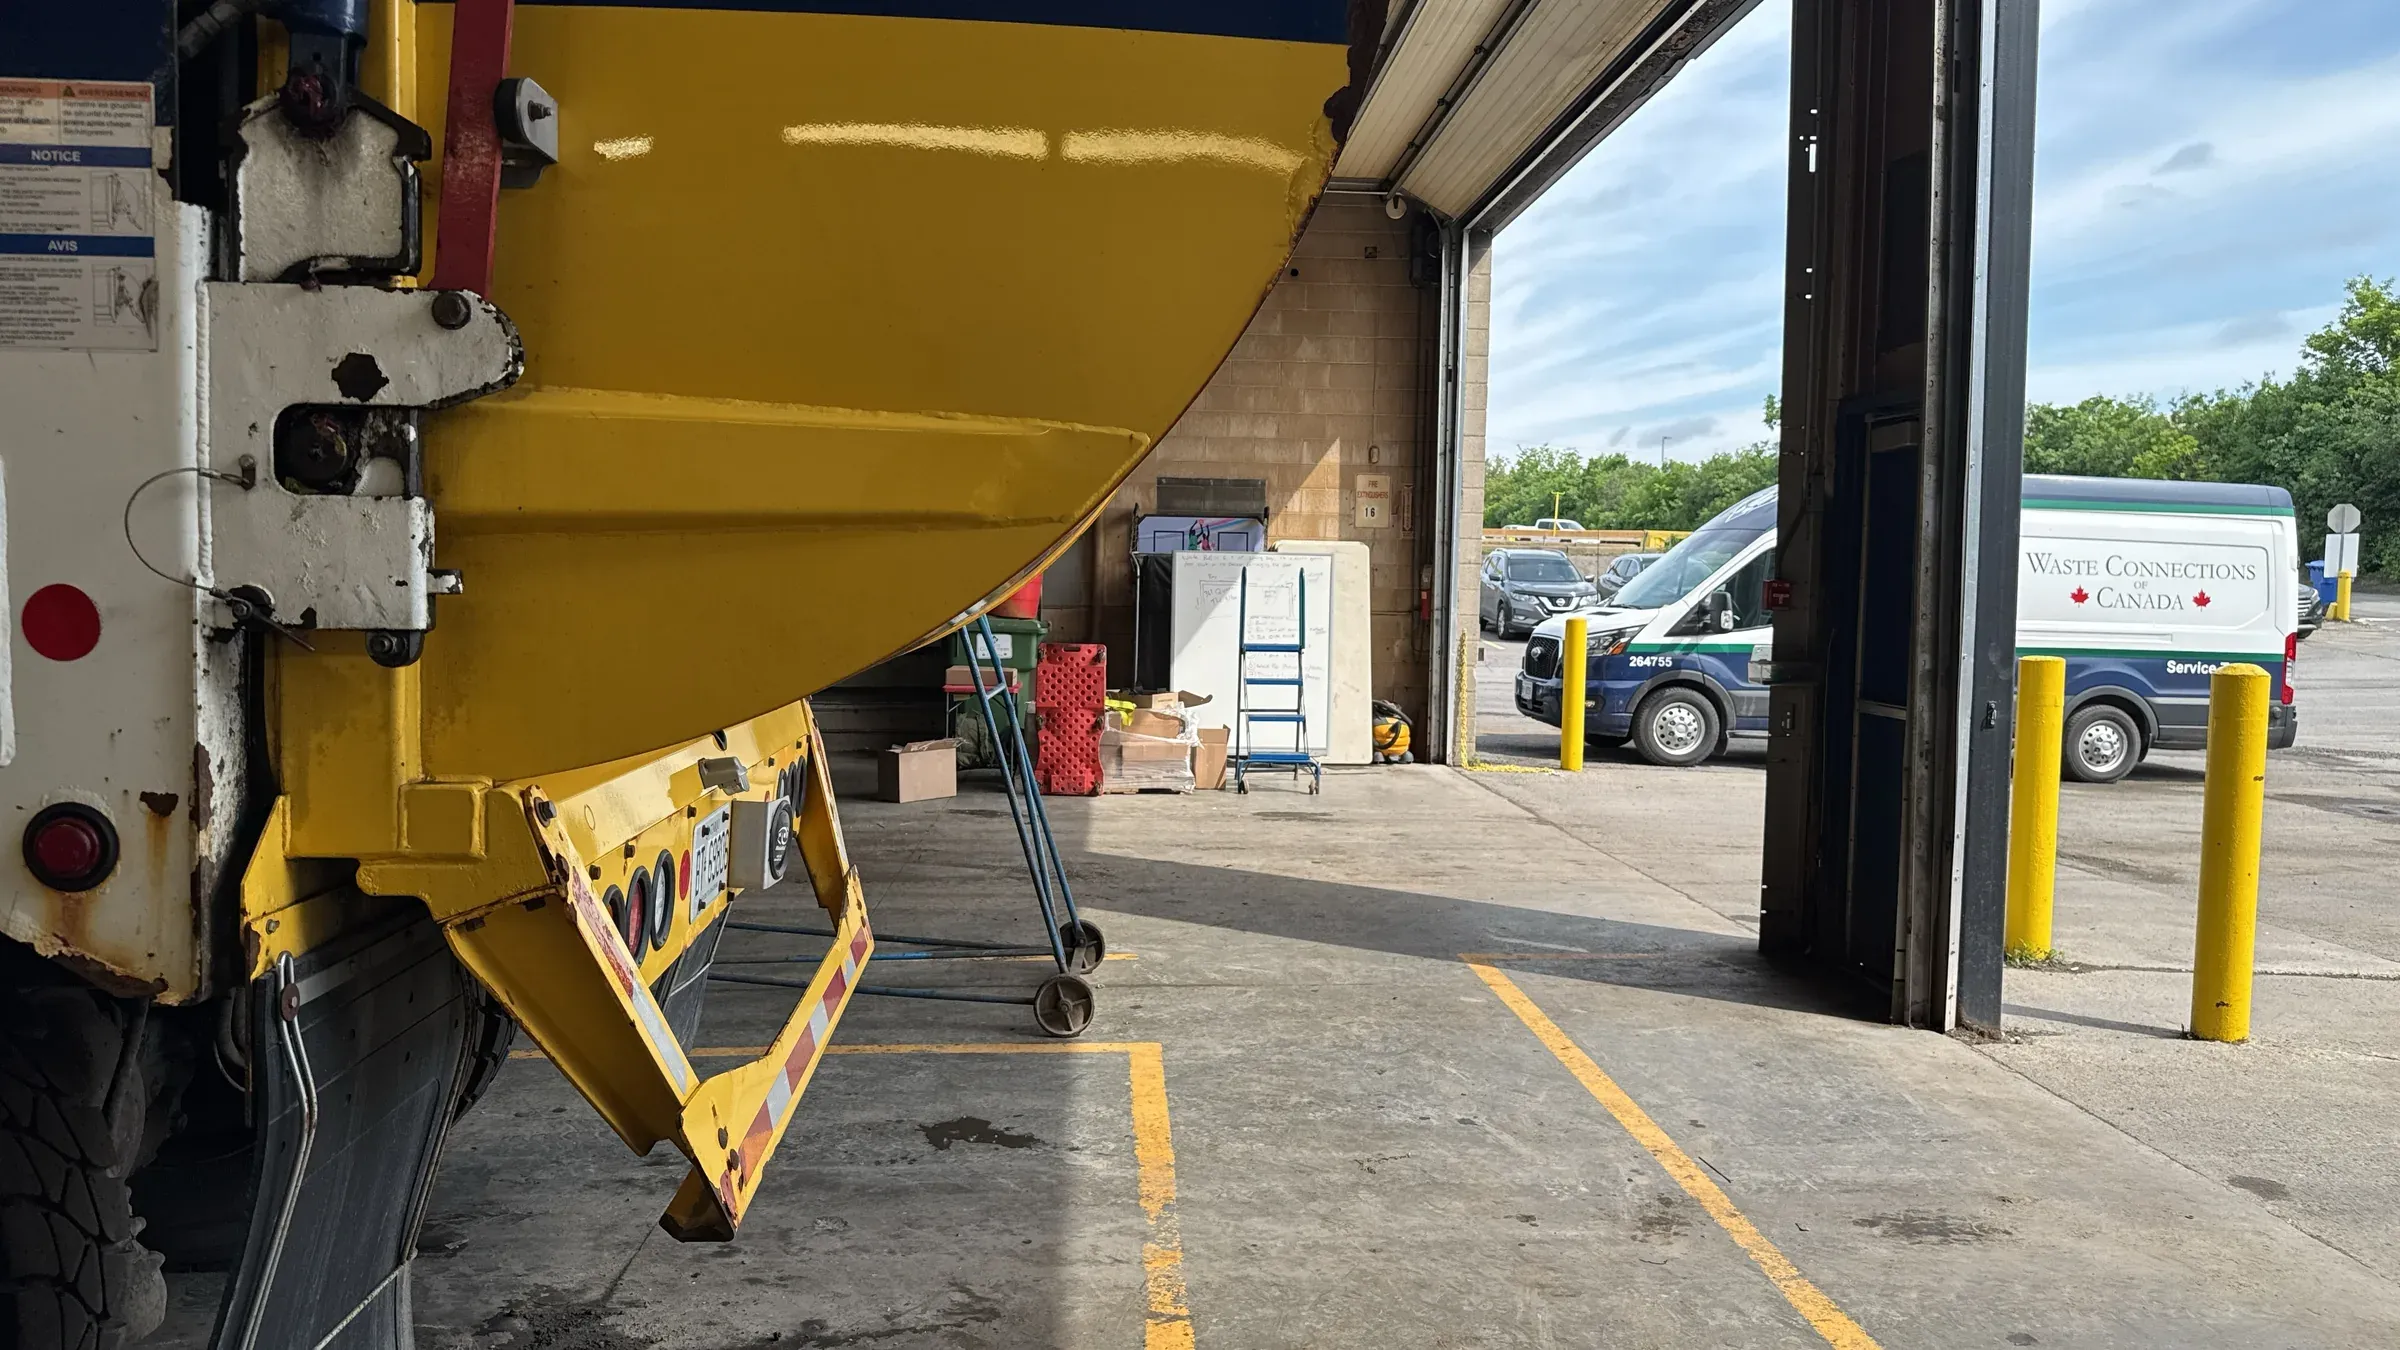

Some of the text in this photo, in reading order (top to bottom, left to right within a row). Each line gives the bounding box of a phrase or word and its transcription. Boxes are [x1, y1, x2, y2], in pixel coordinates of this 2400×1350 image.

[30, 150, 81, 162] NOTICE
[47, 240, 78, 251] AVIS
[1365, 506, 1376, 518] 16
[1629, 656, 1673, 667] 264755
[2166, 659, 2217, 675] Service
